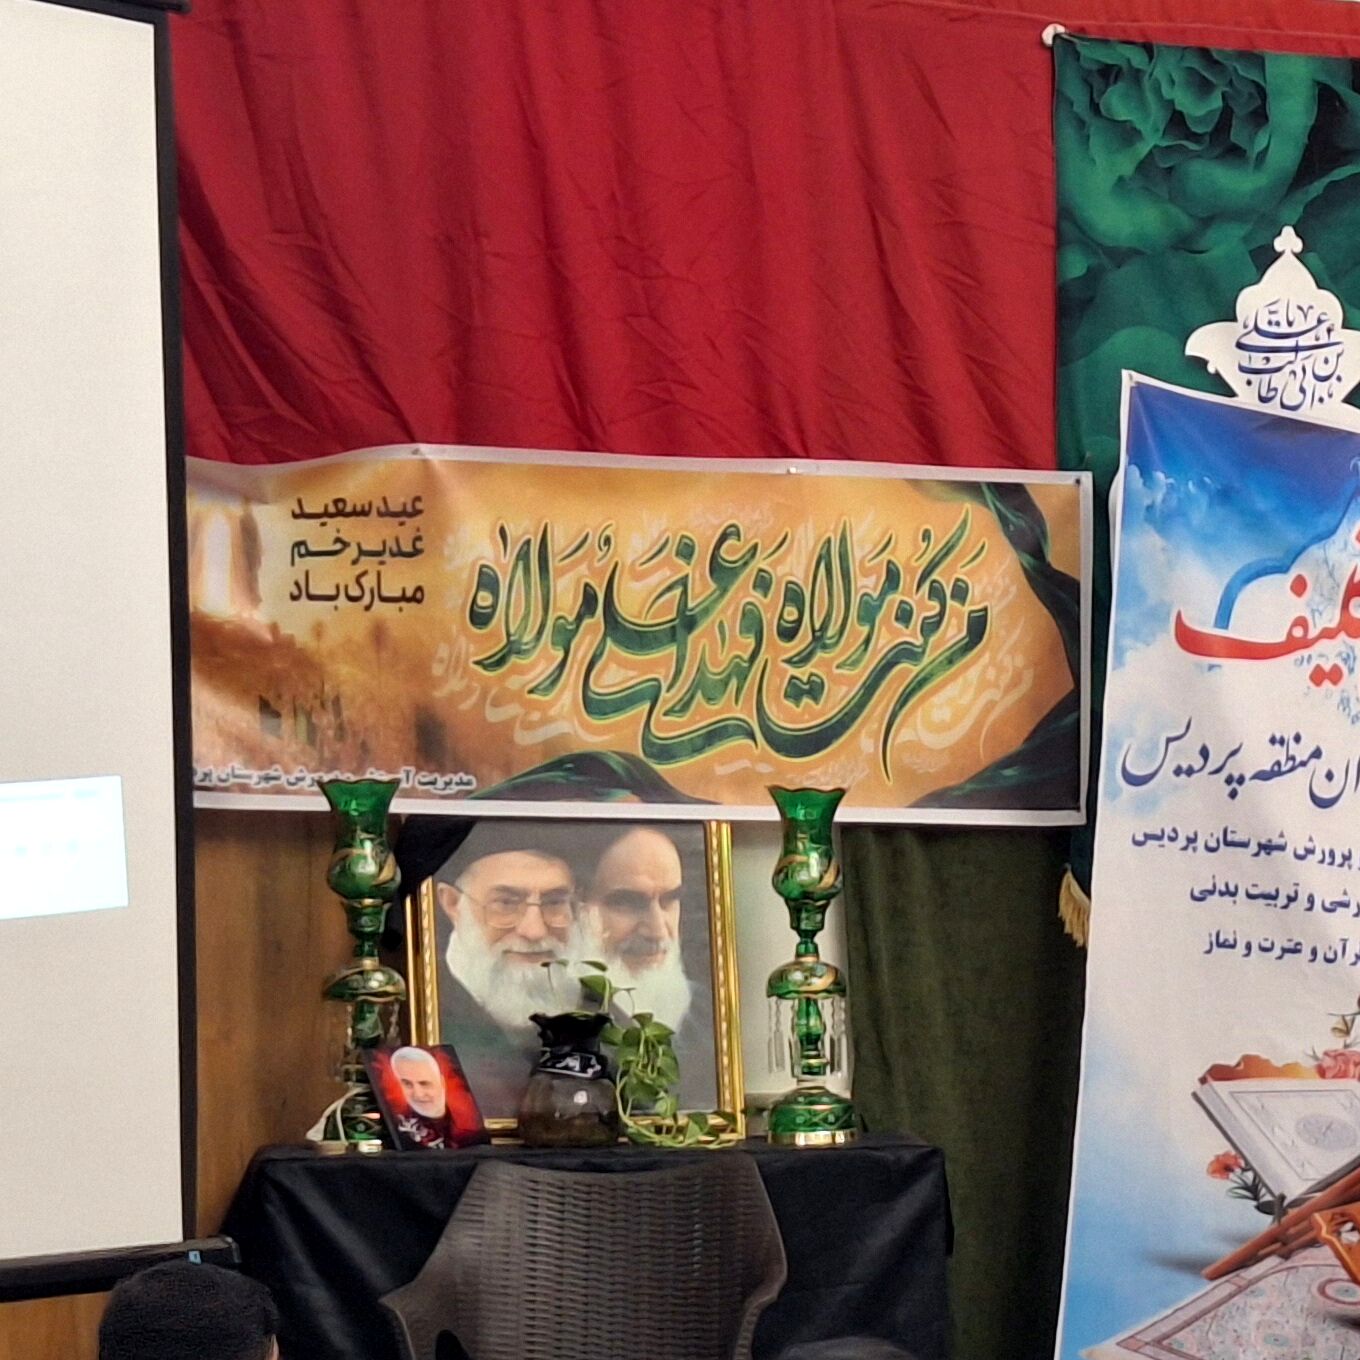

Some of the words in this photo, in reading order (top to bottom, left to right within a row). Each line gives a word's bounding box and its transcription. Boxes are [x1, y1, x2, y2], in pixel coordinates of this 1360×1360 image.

[291, 497, 372, 527] سعید
[376, 495, 424, 526] عید
[290, 527, 351, 567] خم
[351, 526, 425, 566] غدیر
[290, 569, 340, 611] باد
[344, 570, 425, 612] مبارک
[1121, 715, 1244, 801] پردیس
[1131, 824, 1199, 855] پردیس
[1203, 824, 1288, 857] شهرستان
[1292, 835, 1353, 872] پرورش
[1189, 874, 1240, 909] بدنی
[1244, 881, 1301, 910] تربیت
[1305, 895, 1316, 912] و
[1203, 928, 1239, 955] نماز
[1243, 941, 1253, 958] و
[1257, 936, 1304, 959] عترت
[1309, 946, 1319, 963] و
